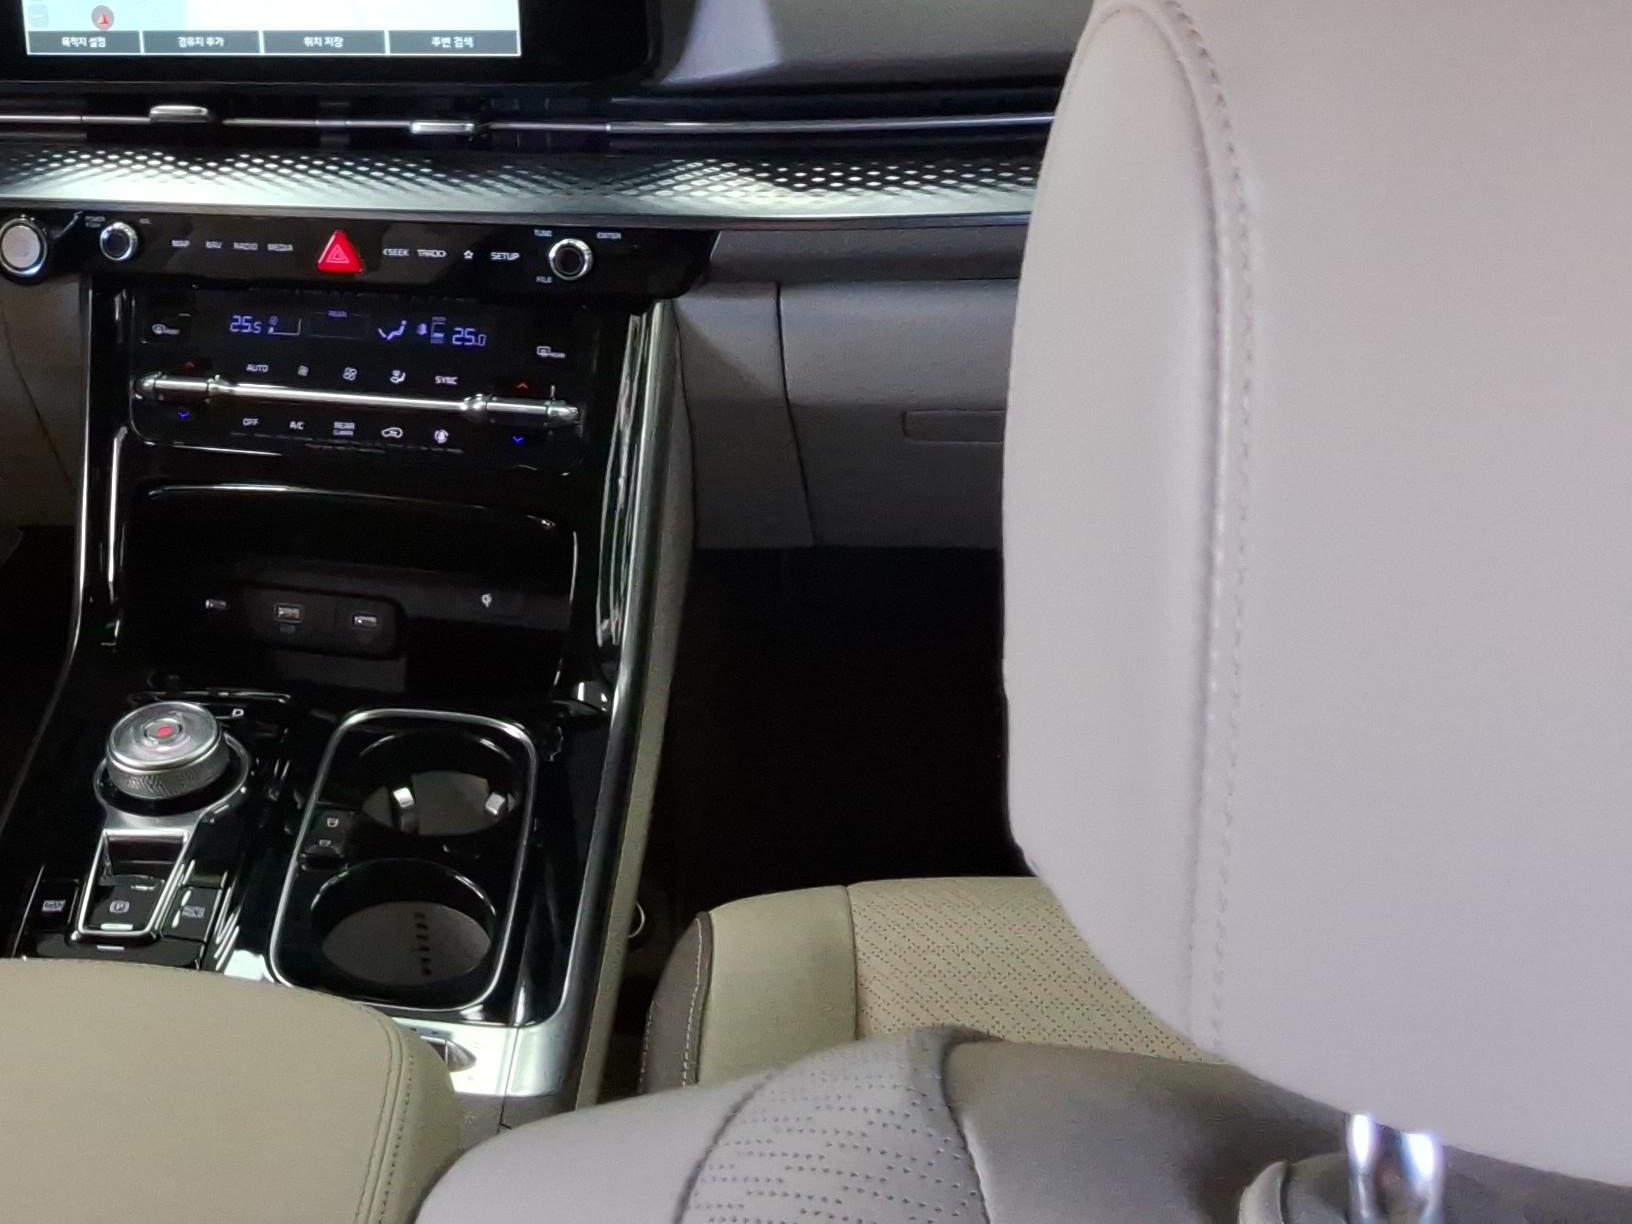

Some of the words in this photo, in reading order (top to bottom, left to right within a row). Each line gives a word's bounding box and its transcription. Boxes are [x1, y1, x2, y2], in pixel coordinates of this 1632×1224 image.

[431, 36, 451, 48] 주변
[453, 36, 474, 48] 검색
[490, 252, 520, 261] SETUP
[230, 315, 262, 333] 25.5
[452, 328, 486, 346] 25.0
[246, 364, 269, 373] AUTO
[435, 376, 458, 385] SYNC
[242, 418, 258, 426] OFF
[289, 420, 305, 430] A/C
